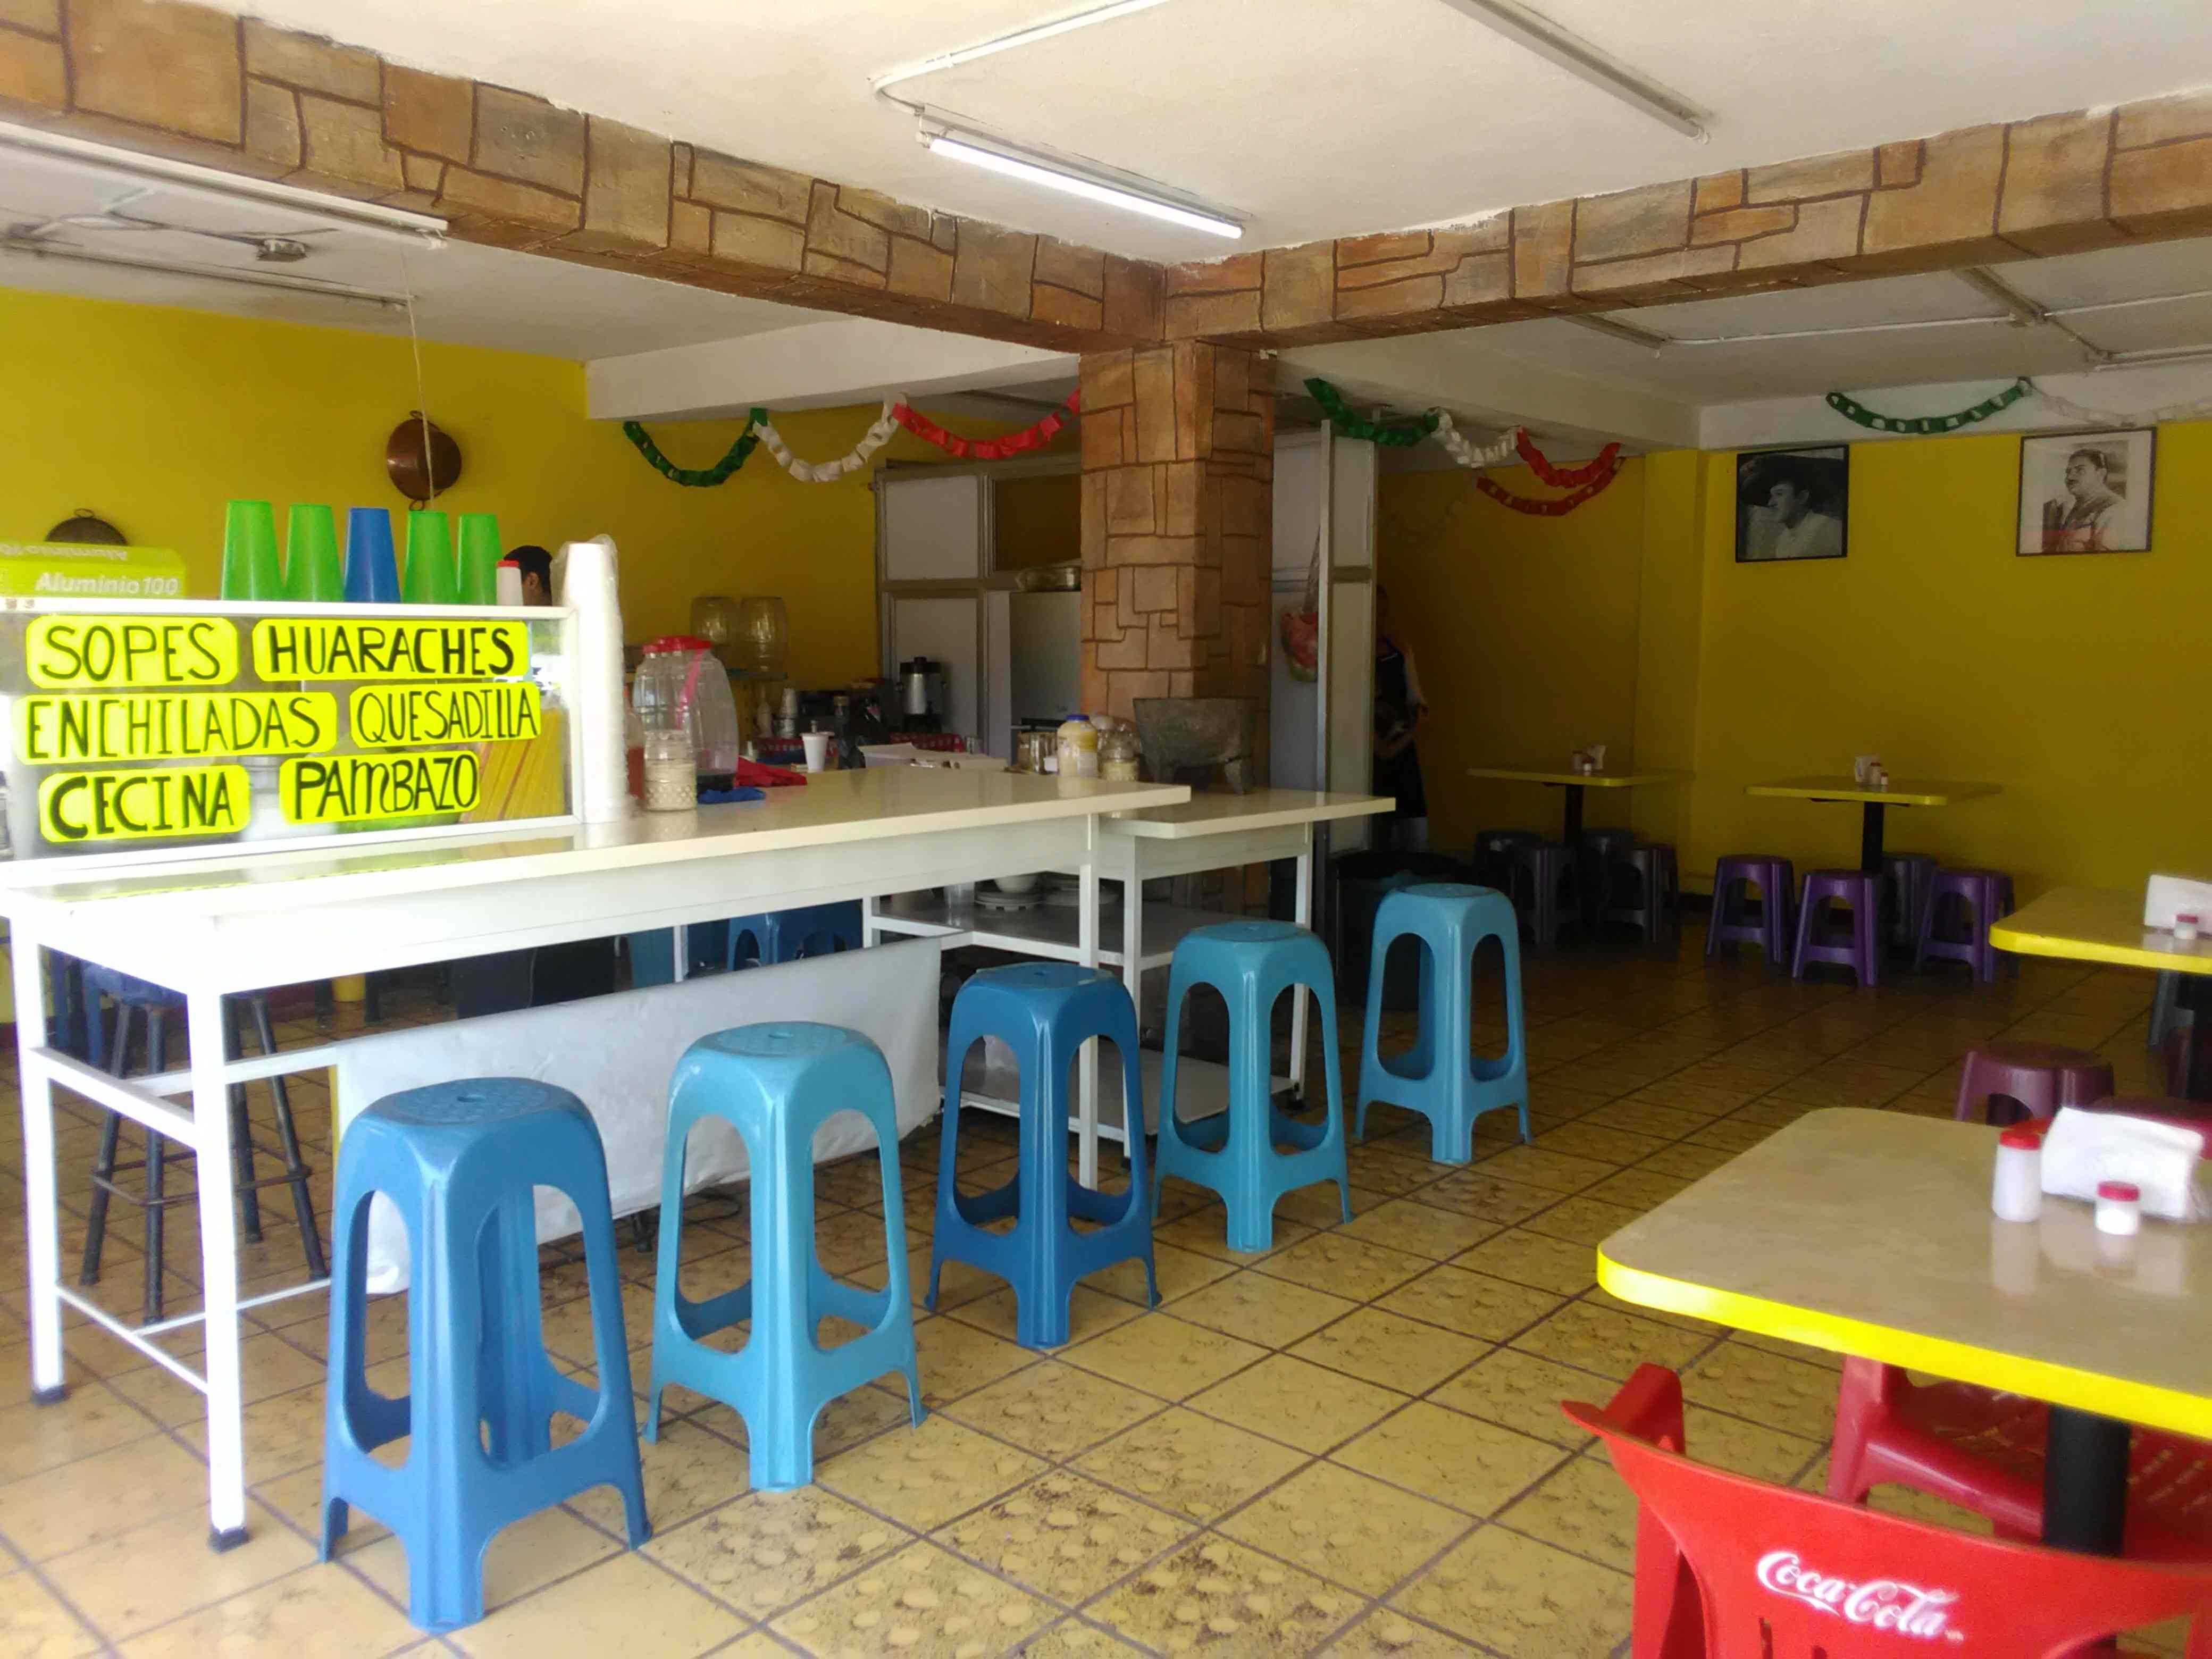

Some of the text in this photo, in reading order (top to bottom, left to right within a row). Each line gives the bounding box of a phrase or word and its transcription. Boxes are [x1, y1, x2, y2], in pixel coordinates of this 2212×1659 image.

[34, 571, 179, 595] Aluminio 100
[40, 623, 220, 681] SOPES
[269, 626, 514, 675] HUARACHES
[27, 697, 320, 758] ENCHILADAS
[357, 688, 537, 743] QUESADILLA
[49, 772, 234, 839] CECINA
[296, 754, 477, 819] PAMBAZO
